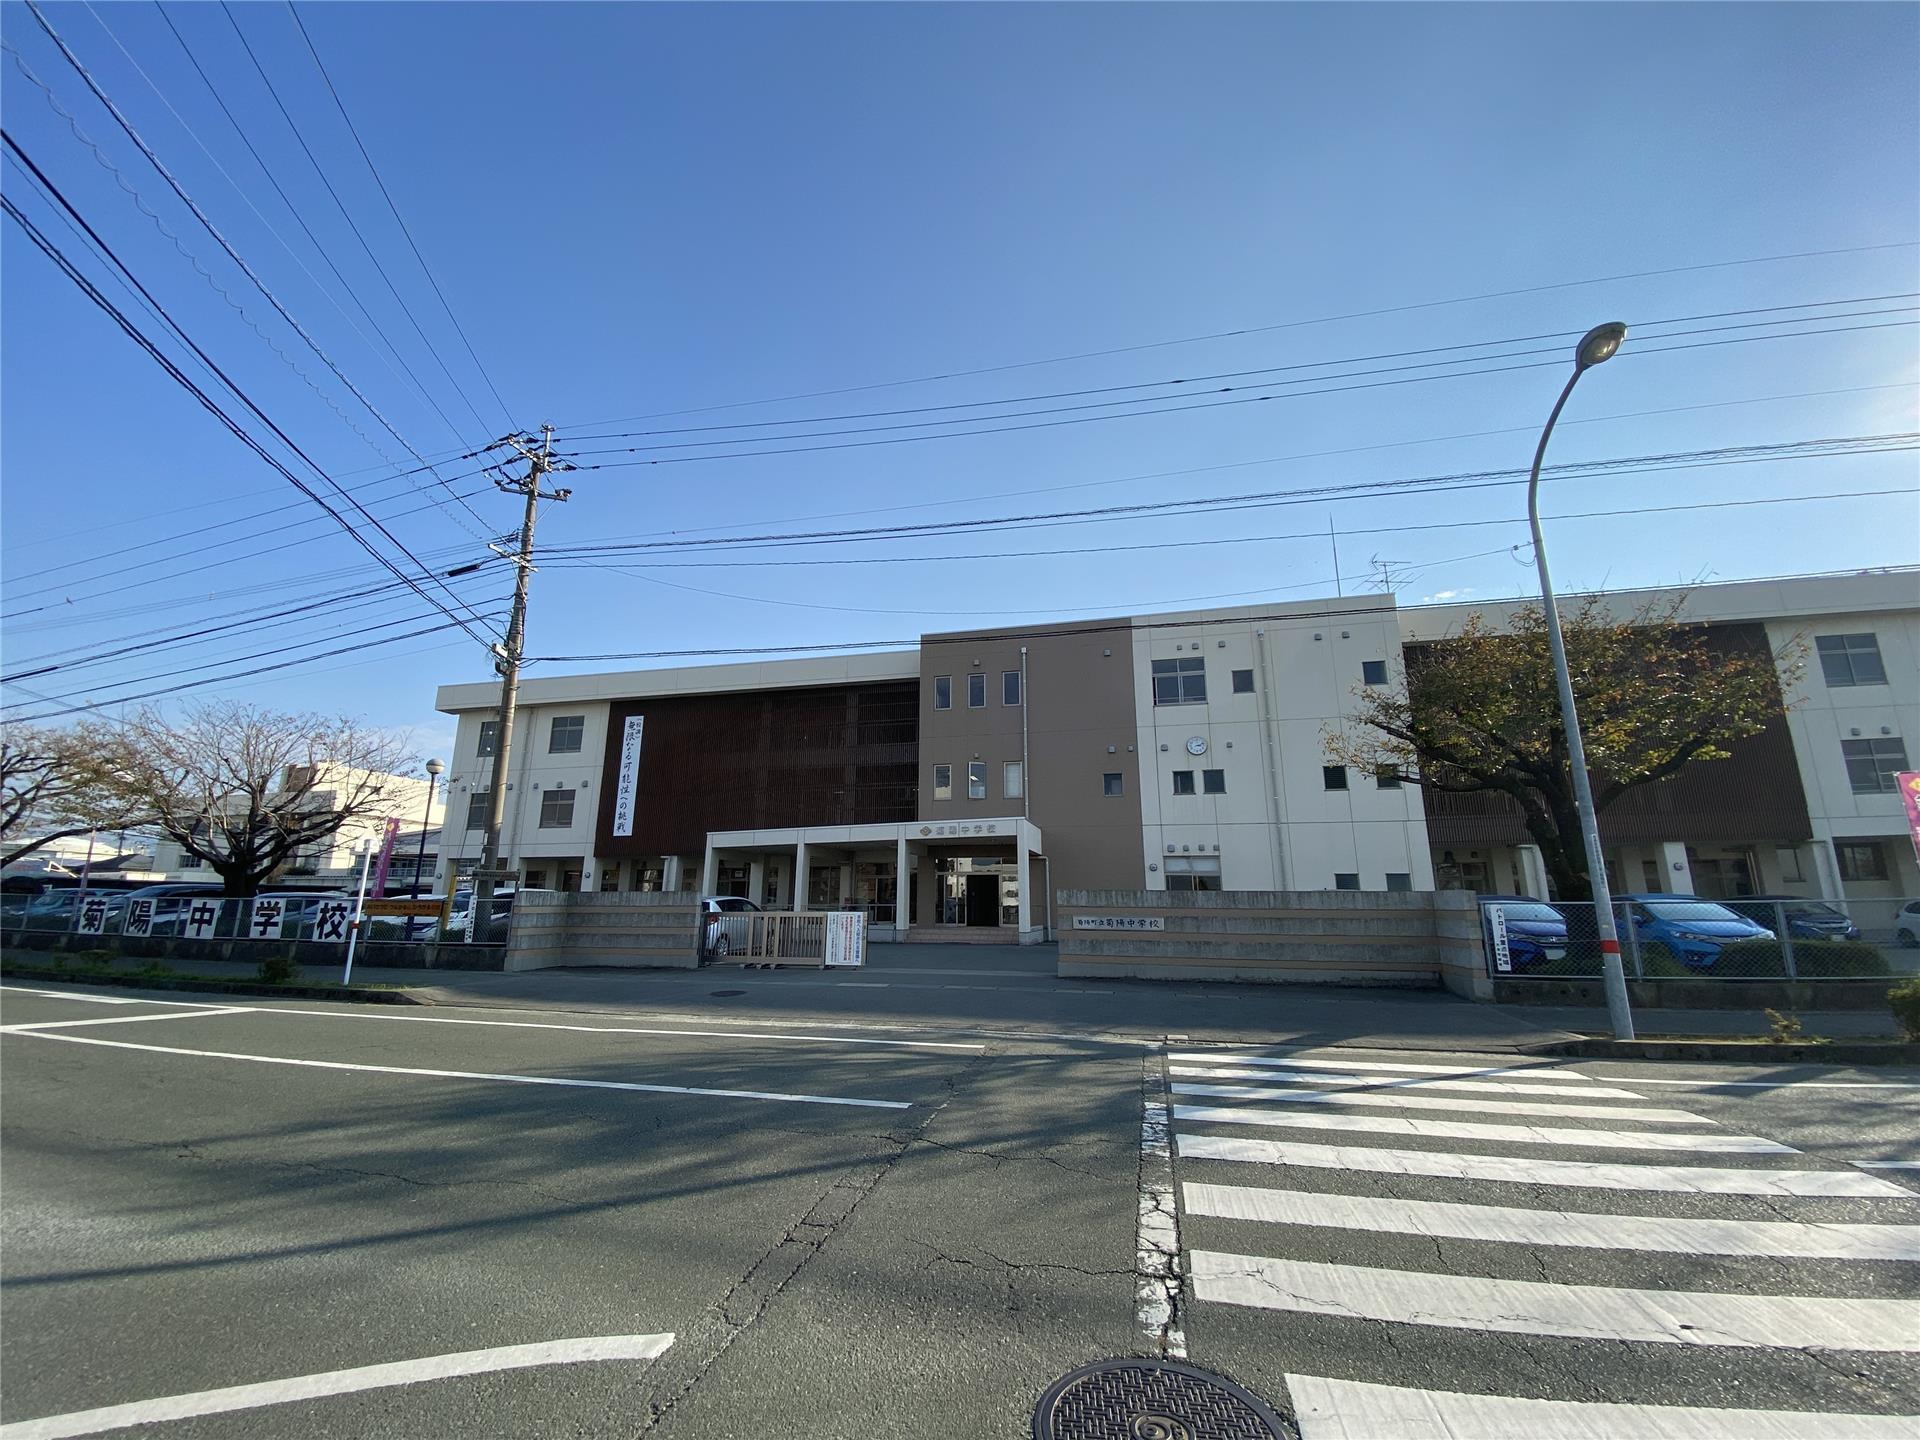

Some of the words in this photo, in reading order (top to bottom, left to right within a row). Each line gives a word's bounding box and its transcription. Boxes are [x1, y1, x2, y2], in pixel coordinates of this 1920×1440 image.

[82, 900, 348, 940] 菊陽中学校
